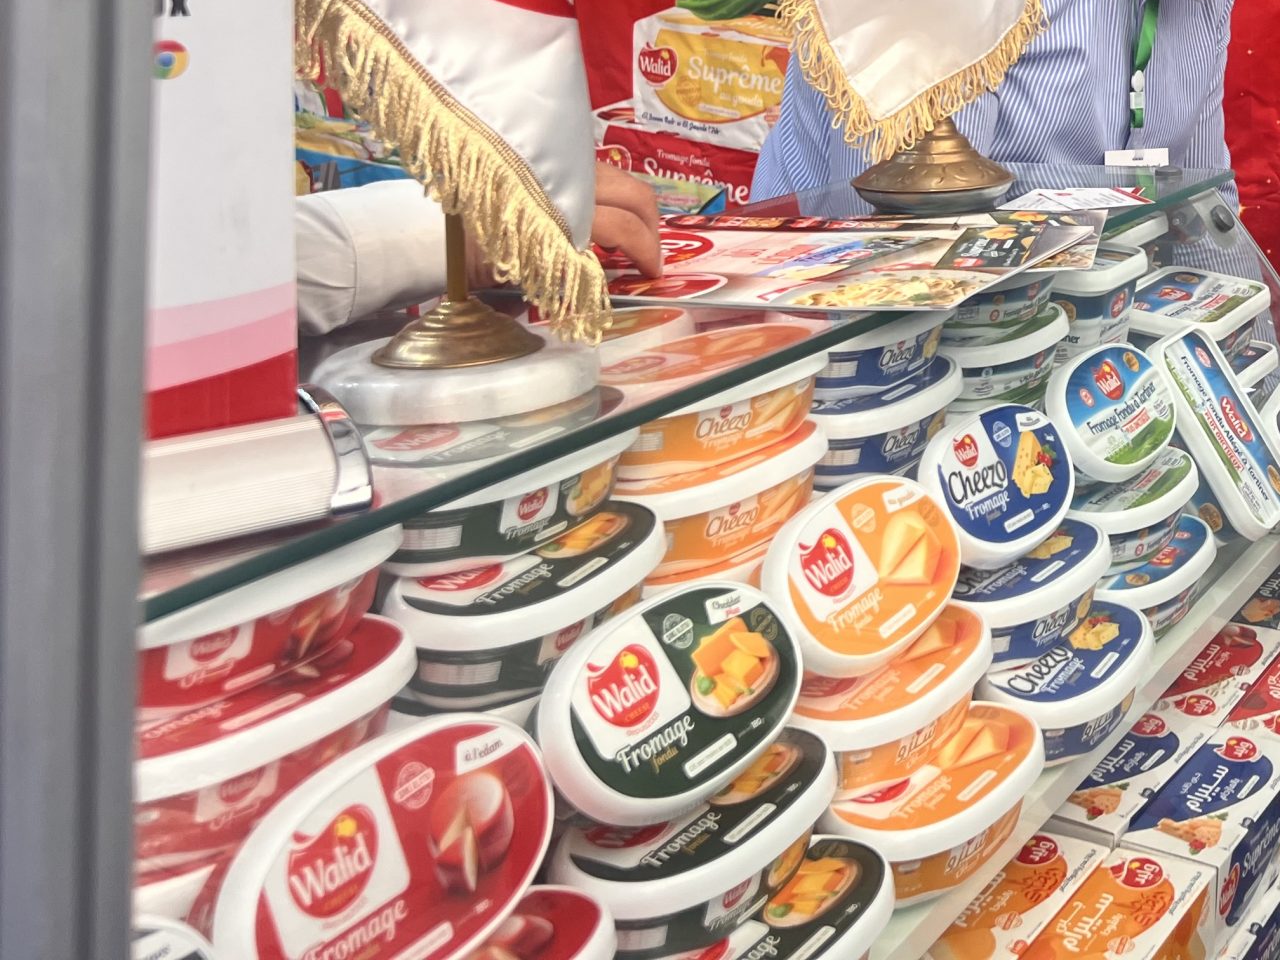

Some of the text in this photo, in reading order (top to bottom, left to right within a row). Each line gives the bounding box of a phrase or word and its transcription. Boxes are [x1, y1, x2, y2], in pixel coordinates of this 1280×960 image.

[639, 55, 672, 77] Walid
[687, 54, 783, 94] Suprême
[880, 346, 915, 368] Cheezo
[1096, 370, 1122, 395] Walid
[696, 412, 752, 439] Cheezo
[1086, 415, 1118, 436] Fromage
[1114, 401, 1137, 422] Fondu
[1181, 355, 1208, 397] Fromage
[1206, 394, 1226, 432] Fondu
[1224, 430, 1245, 458] Allégé
[1246, 463, 1271, 502] Tartiner
[1221, 397, 1247, 439] Walid
[883, 431, 918, 453] Cheezo
[948, 460, 1007, 505] Cheezo
[518, 497, 545, 515] Walid
[705, 506, 758, 538] Cheezo
[965, 490, 1010, 520] Fromage
[475, 561, 554, 606] Fromage
[804, 544, 853, 590] Walid
[827, 588, 884, 633] Fromage
[1007, 645, 1070, 694] Cheezo
[1040, 656, 1086, 695] Fromage
[591, 664, 658, 720] Walid
[615, 714, 696, 775] Fromage
[650, 746, 680, 775] fondu
[1233, 741, 1254, 758] وليد
[640, 810, 722, 869] Fromage
[1029, 839, 1055, 862] وليد
[290, 832, 374, 908] Walid
[1135, 862, 1160, 885] وليد
[302, 898, 408, 960] Fromage
